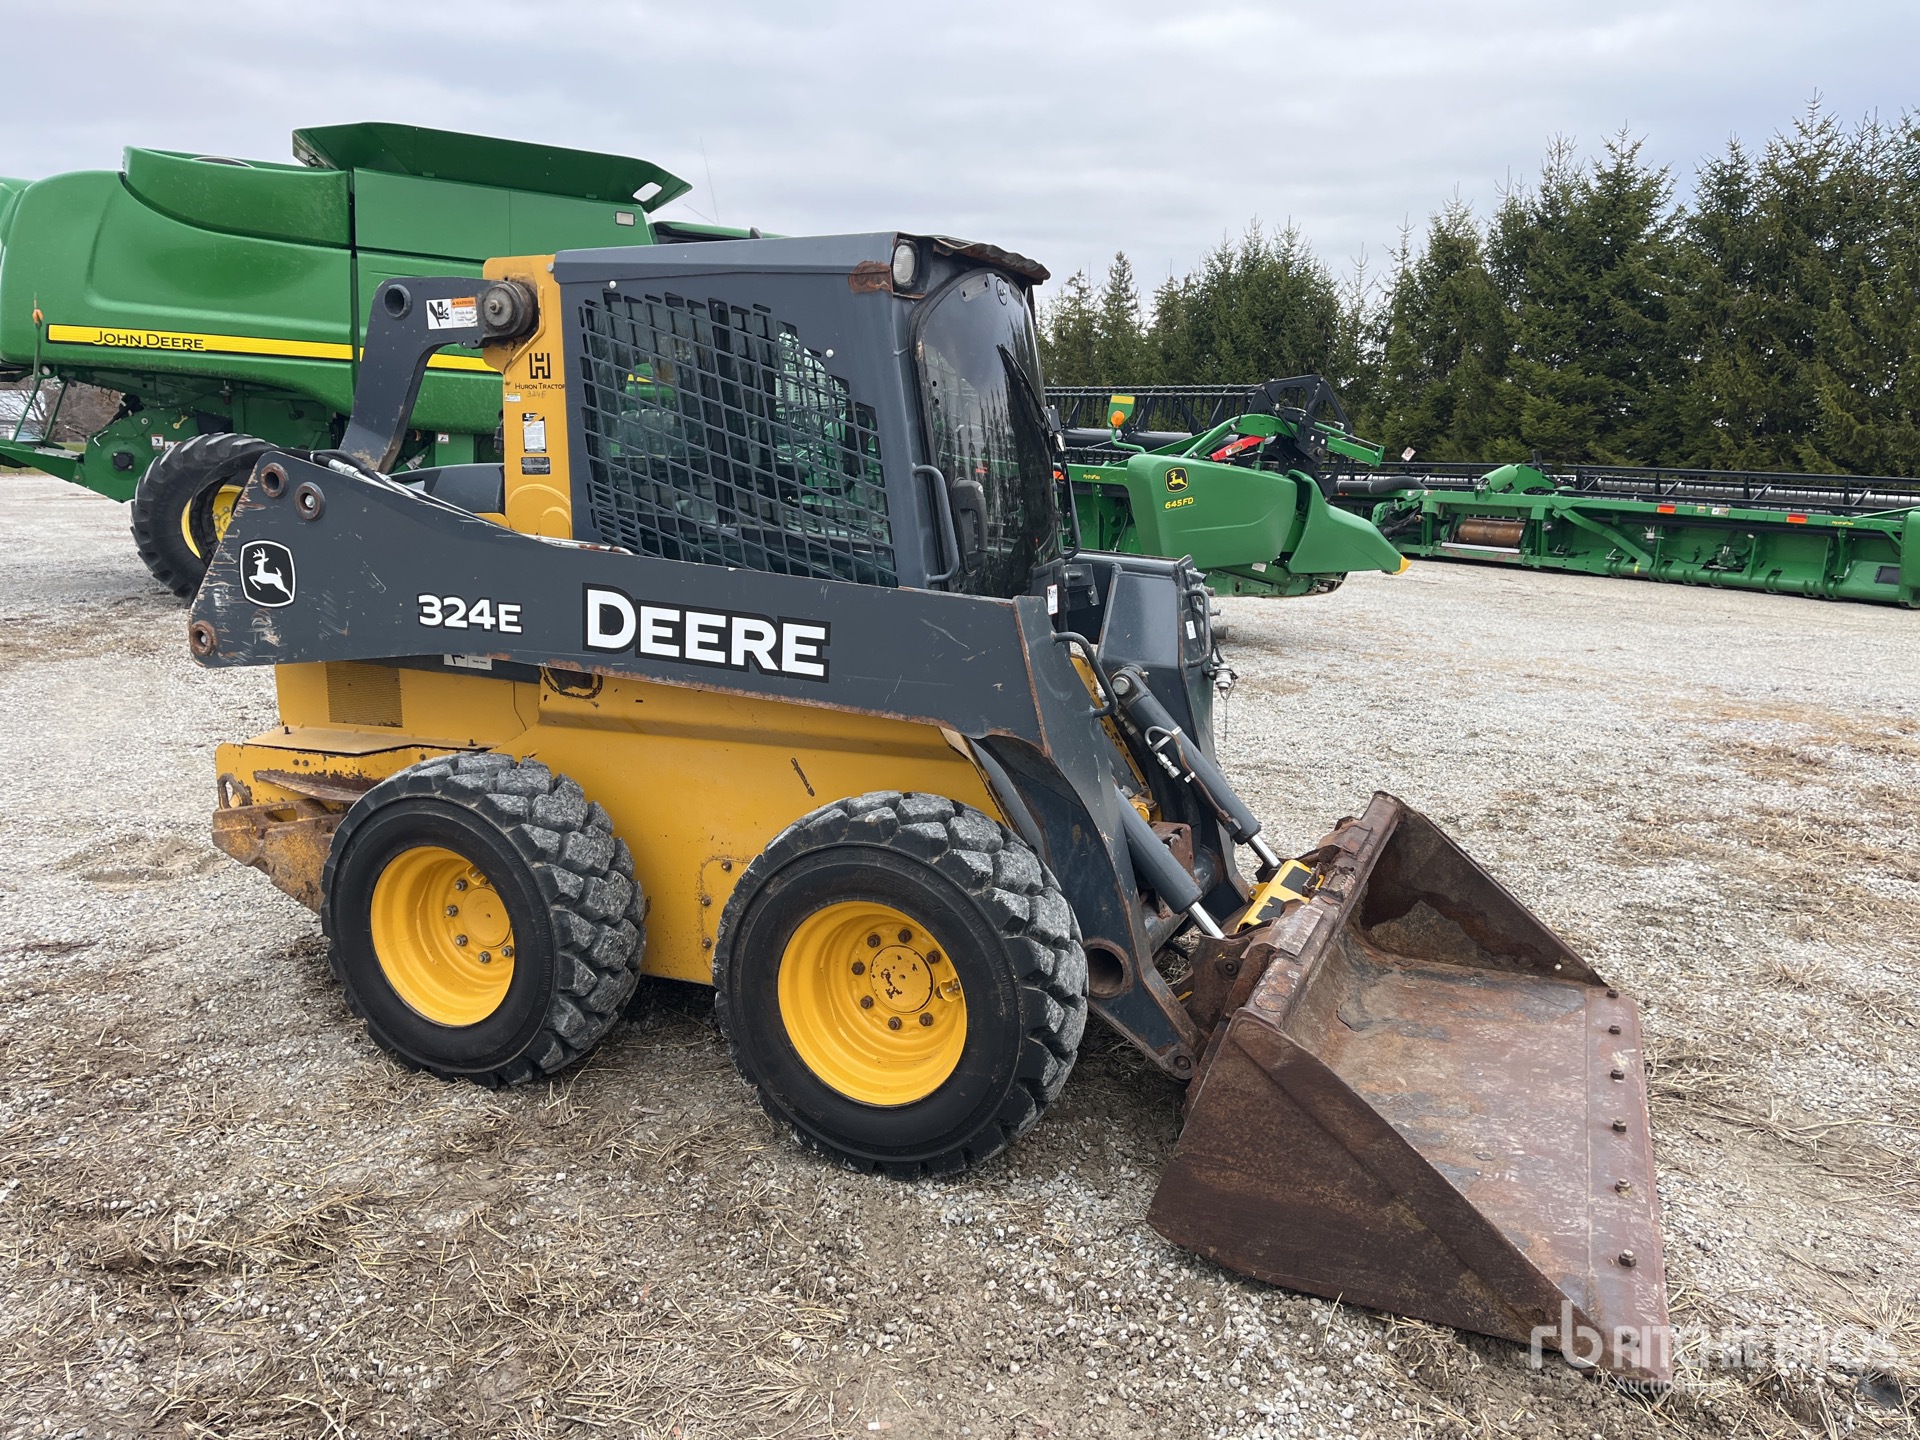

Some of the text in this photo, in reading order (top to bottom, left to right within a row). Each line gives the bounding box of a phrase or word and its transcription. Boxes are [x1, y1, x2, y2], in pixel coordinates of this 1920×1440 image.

[93, 330, 204, 349] JOHN DEERE
[1164, 496, 1194, 510] 645FD
[417, 594, 522, 633] 324E
[586, 588, 827, 678] DEERE
